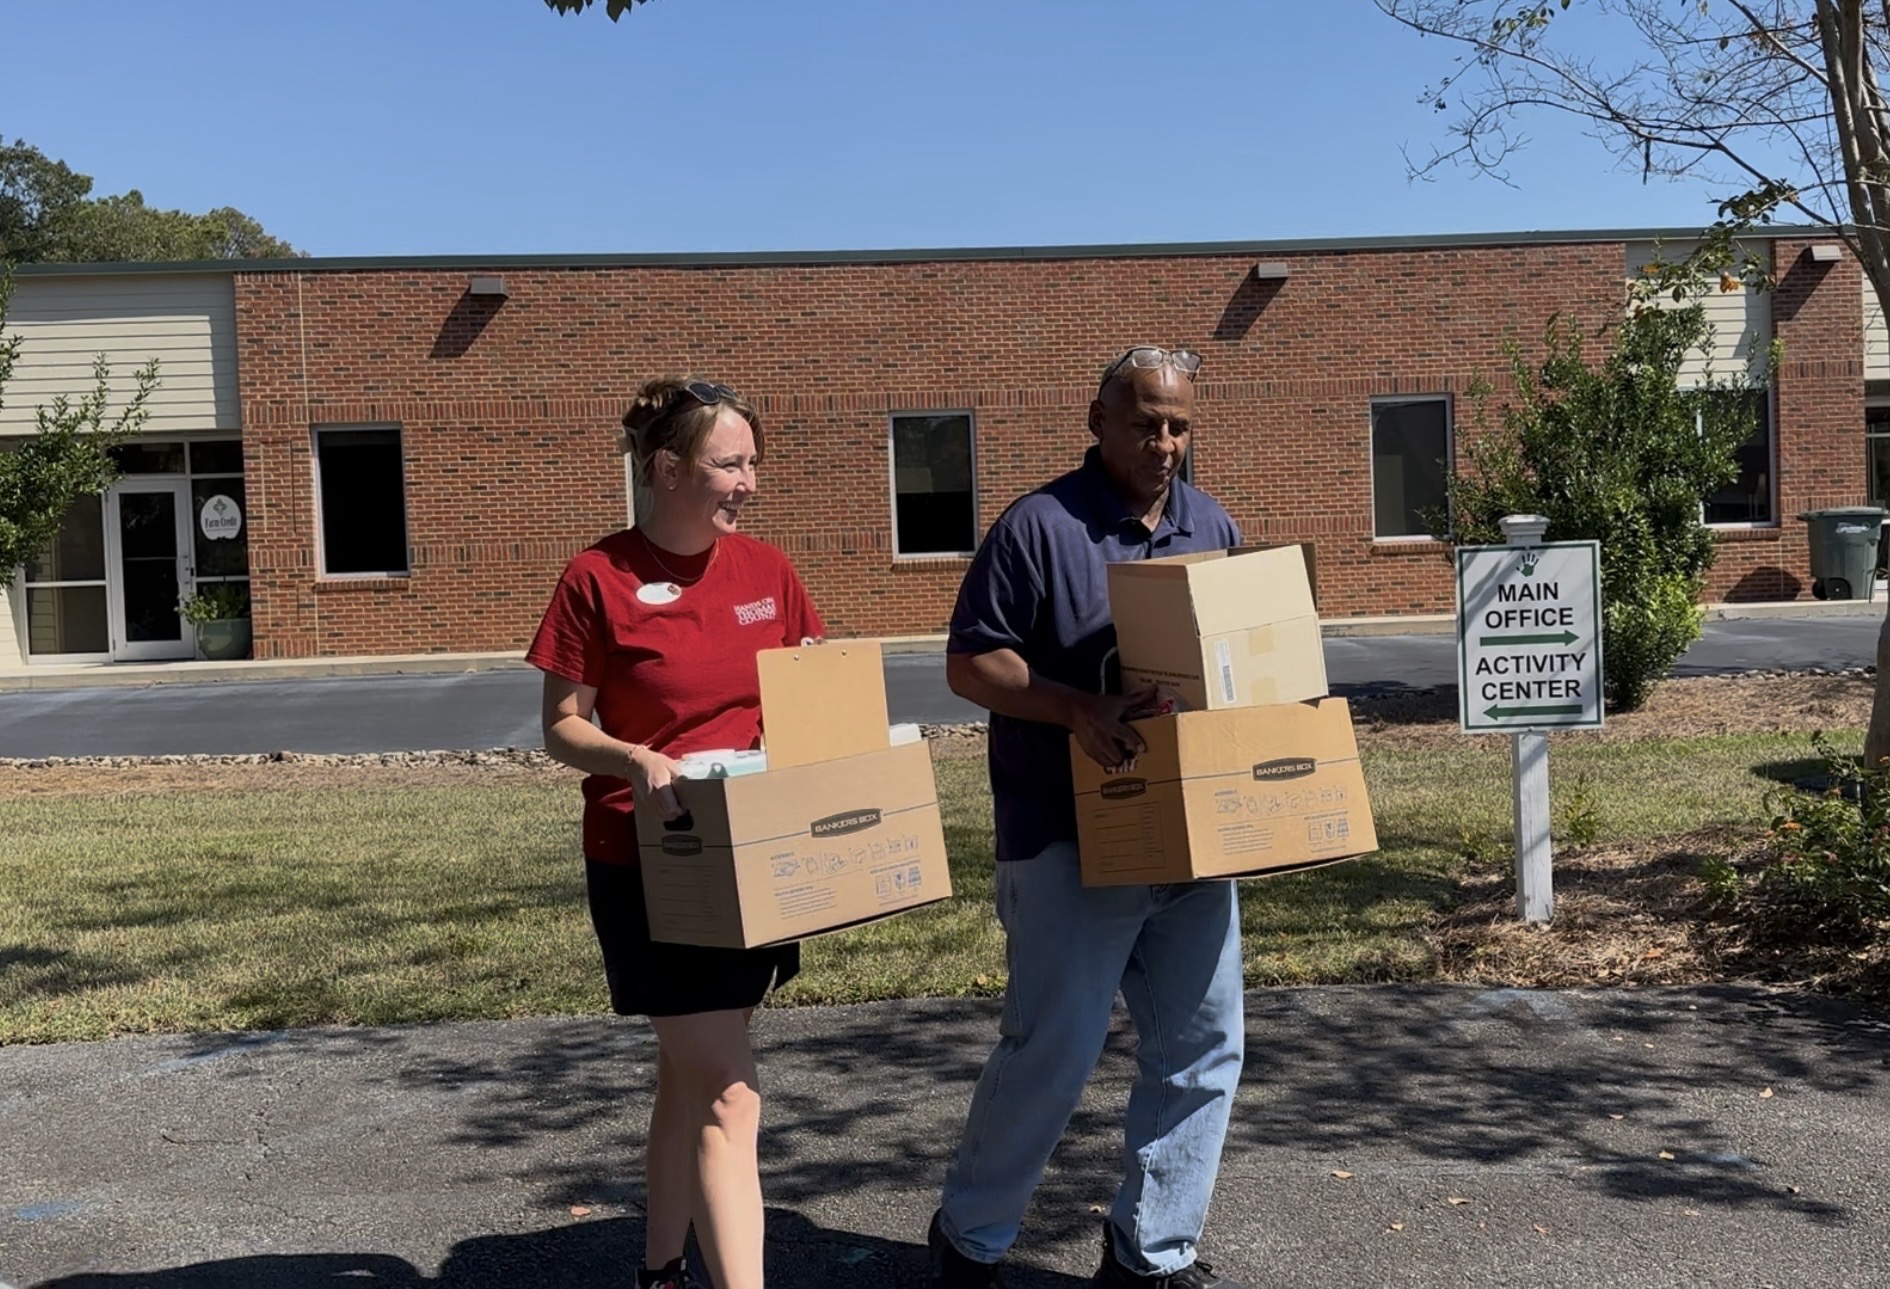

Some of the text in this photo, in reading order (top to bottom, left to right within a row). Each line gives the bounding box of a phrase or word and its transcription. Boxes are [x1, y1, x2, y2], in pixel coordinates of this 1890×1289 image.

[1498, 582, 1559, 602] MAIN
[1485, 607, 1574, 629] OFFICE
[1475, 652, 1586, 675] ACTIVITY
[1482, 679, 1582, 701] CENTER
[1256, 765, 1296, 776] BANKERS
[814, 817, 858, 833] BANKERS
